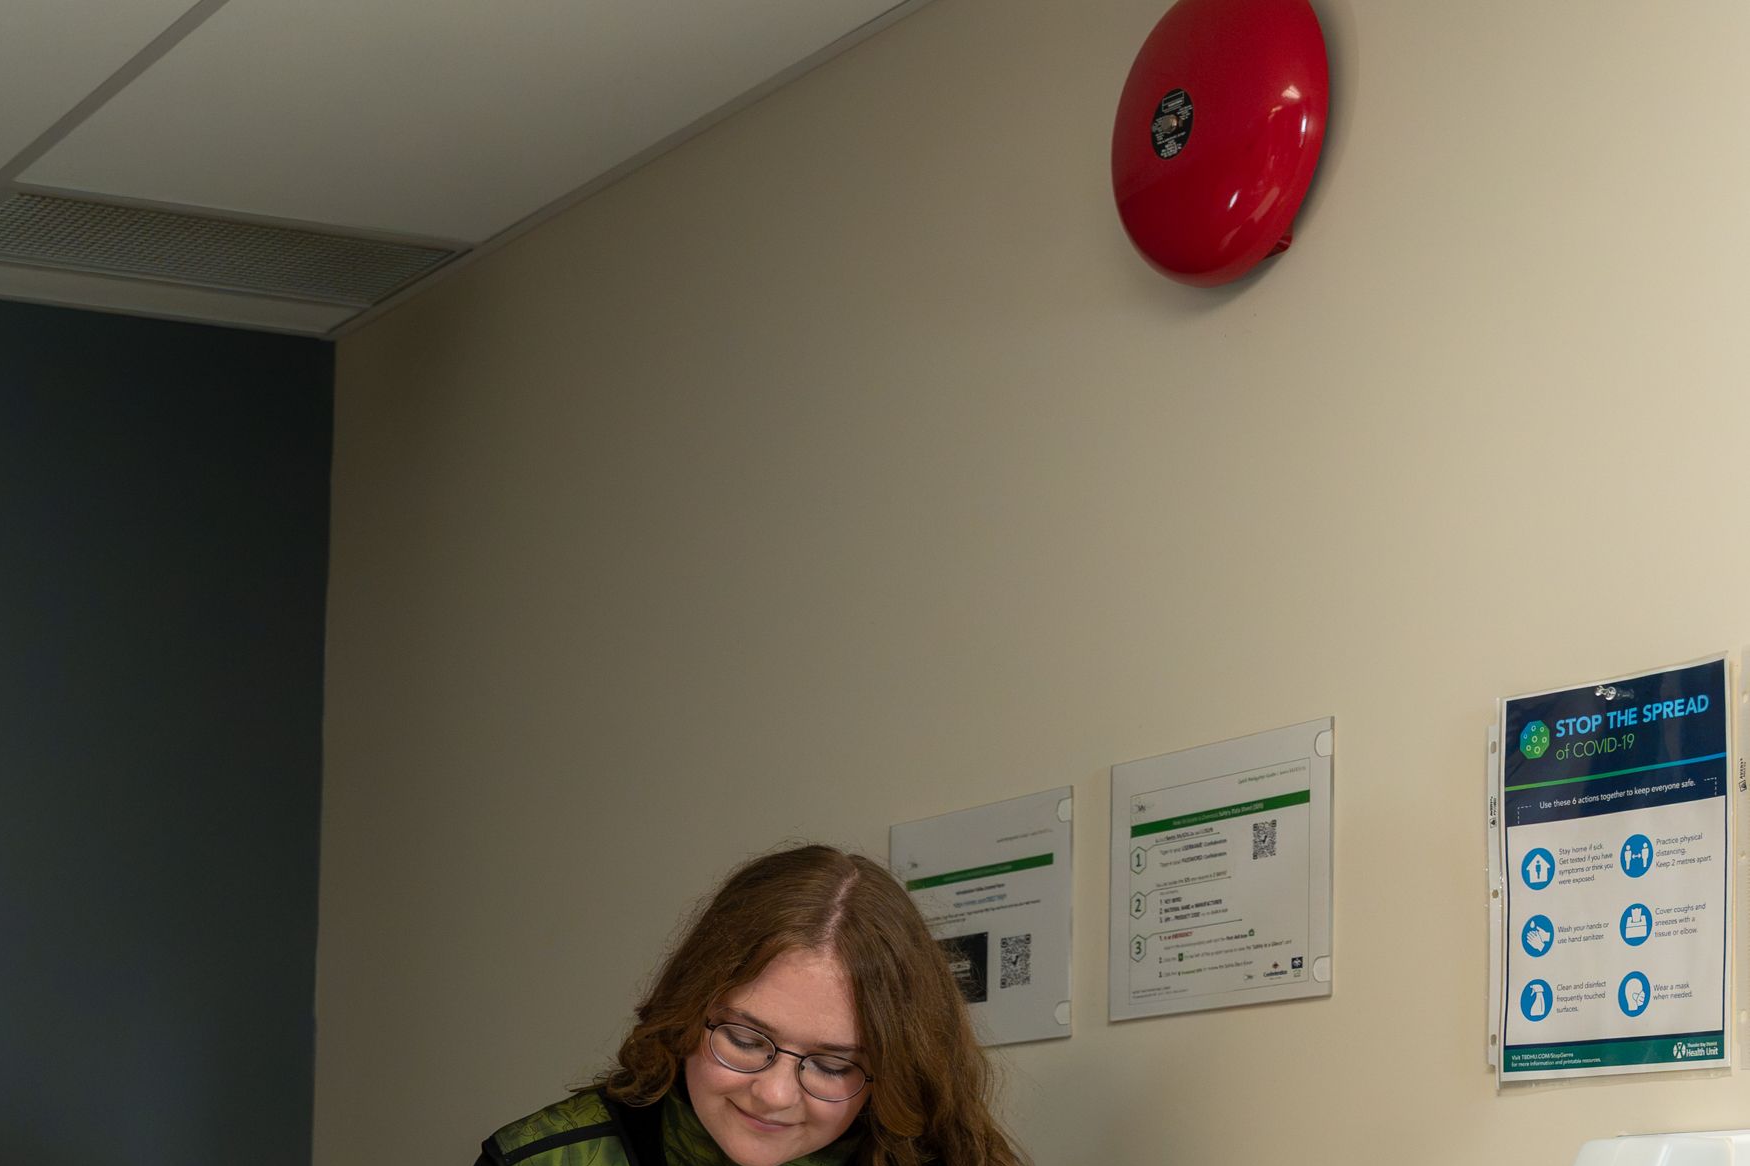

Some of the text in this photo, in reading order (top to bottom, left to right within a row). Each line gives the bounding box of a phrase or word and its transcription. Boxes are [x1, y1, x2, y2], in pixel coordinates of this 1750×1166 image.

[1556, 694, 1709, 738] STOP THE SPREAD
[1556, 733, 1635, 760] of COVID-19
[1539, 801, 1552, 809] Use
[1553, 798, 1571, 808] these
[1572, 797, 1577, 805] 6
[1578, 793, 1599, 804] actions
[1600, 789, 1626, 801] together
[1634, 785, 1650, 797] keep
[1651, 782, 1680, 793] everyone
[1680, 778, 1696, 789] safe.
[1680, 832, 1703, 844] physical
[1559, 847, 1570, 855] Stay
[1136, 854, 1141, 867] 1
[1559, 857, 1569, 865] Get
[1570, 855, 1586, 863] tested
[1591, 855, 1601, 863] you
[1601, 852, 1613, 860] have
[1559, 867, 1584, 876] symptoms
[1604, 863, 1613, 871] you
[1656, 861, 1670, 869] Keep
[1135, 898, 1141, 912] 2
[1655, 902, 1706, 915] Cover coughs and
[1678, 915, 1690, 923] with
[1558, 925, 1572, 933] Wash
[1573, 926, 1586, 934] your
[1586, 922, 1602, 930] hands
[1568, 935, 1582, 943] hand
[1135, 941, 1142, 955] 3
[1573, 981, 1583, 990] and
[1585, 980, 1606, 989] disinfect
[1675, 982, 1690, 990] mask
[1557, 991, 1605, 1003] frequently touched
[1686, 1047, 1719, 1057] Health Unit
